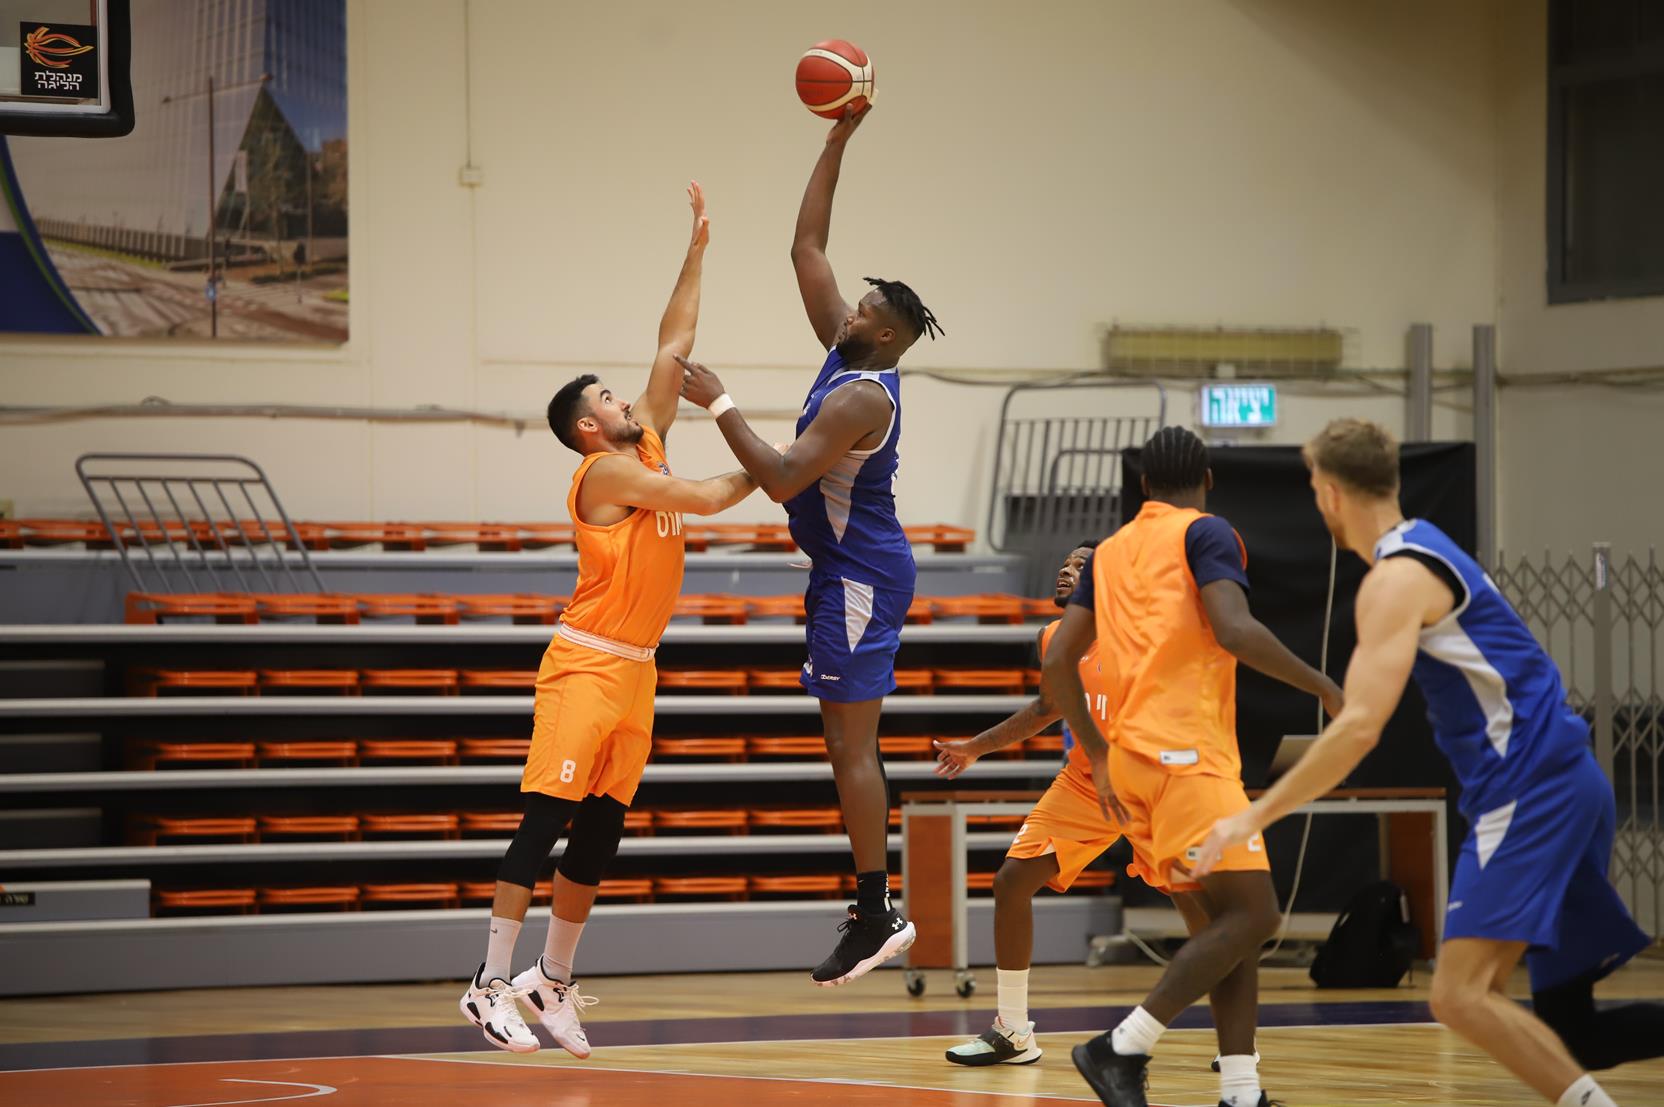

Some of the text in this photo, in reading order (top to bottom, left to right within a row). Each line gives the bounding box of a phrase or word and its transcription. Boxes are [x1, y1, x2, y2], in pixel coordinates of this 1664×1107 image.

[34, 70, 83, 82] מנהלת
[37, 79, 80, 91] הליגה
[559, 759, 577, 783] 8
